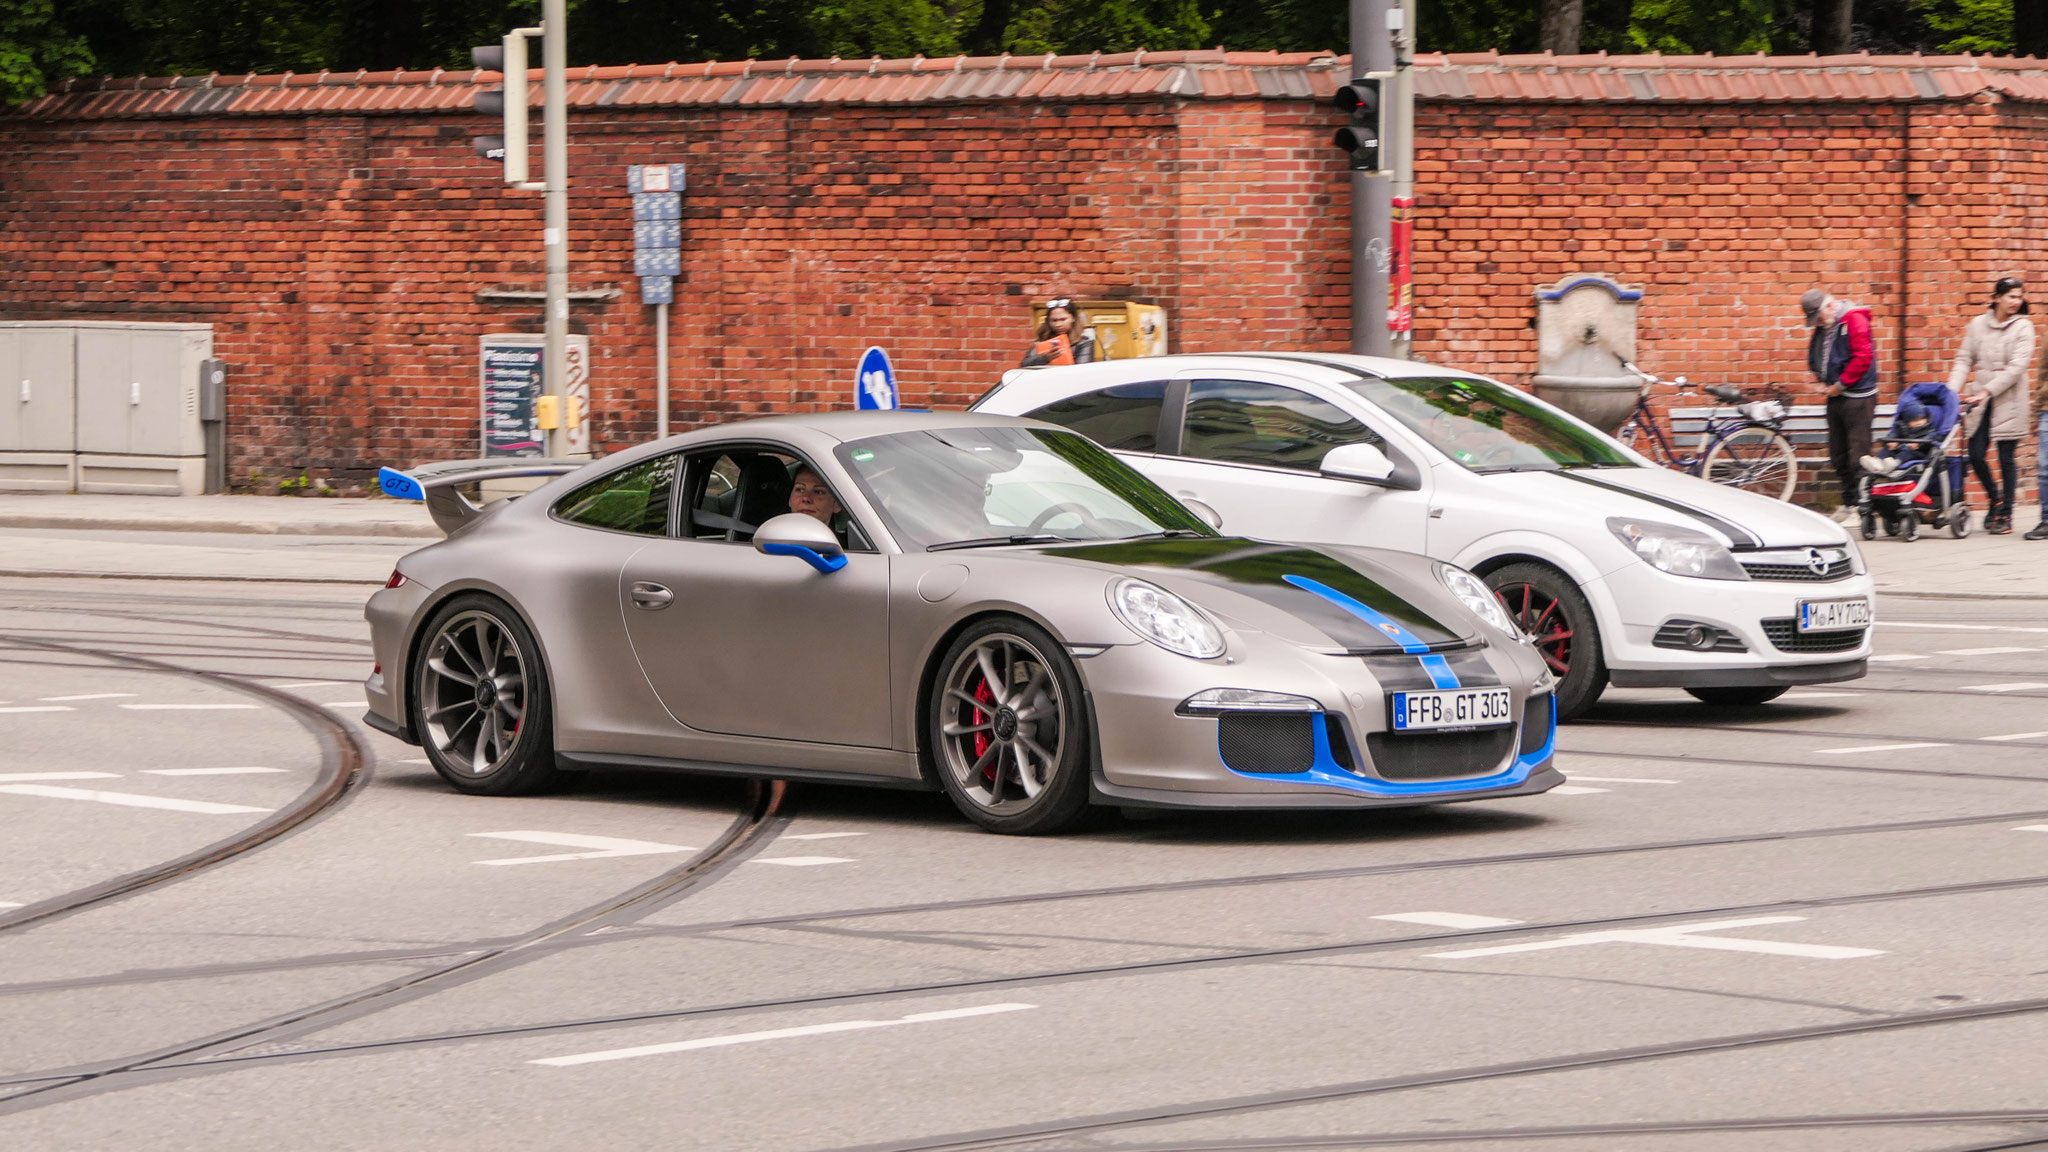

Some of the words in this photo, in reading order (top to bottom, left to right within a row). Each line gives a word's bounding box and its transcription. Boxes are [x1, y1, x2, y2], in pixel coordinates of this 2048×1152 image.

[385, 478, 411, 492] GT3
[1809, 604, 1818, 625] M
[1828, 604, 1844, 625] AY
[1398, 713, 1404, 722] D
[1408, 696, 1442, 723] FFB
[1456, 694, 1476, 720] GT
[1481, 692, 1509, 719] 303
